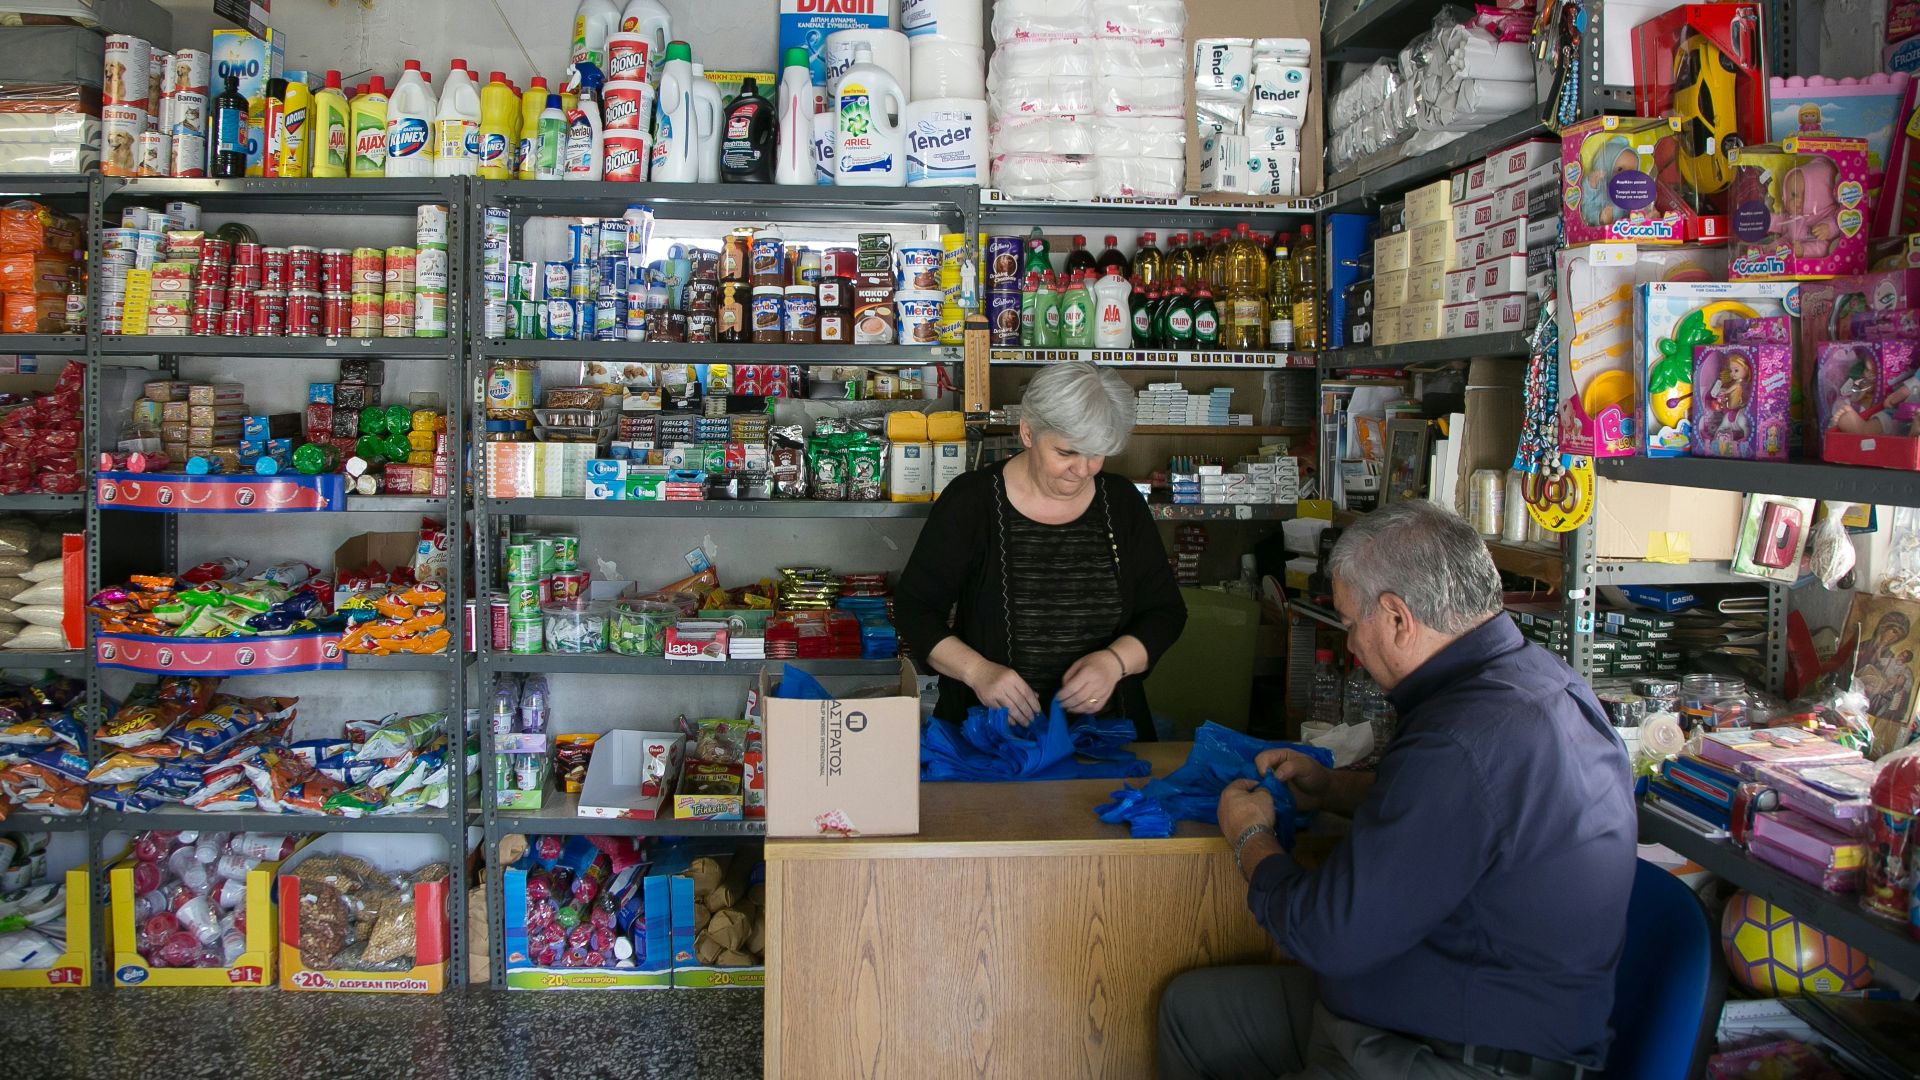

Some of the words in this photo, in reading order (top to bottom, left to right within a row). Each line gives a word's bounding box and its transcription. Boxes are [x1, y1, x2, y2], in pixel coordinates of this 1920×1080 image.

[105, 41, 129, 50] arron
[218, 59, 260, 78] OMO
[610, 51, 645, 74] BIONOL
[1255, 84, 1300, 101] Tender
[104, 110, 137, 121] Barron
[605, 101, 638, 123] BIONOL
[388, 131, 426, 149] KLINEX
[844, 138, 872, 147] ARIEL
[908, 126, 972, 153] Tender
[651, 143, 668, 158] RIEL
[605, 148, 640, 172] BIONOL
[1065, 312, 1082, 320] FAIRY
[1104, 304, 1121, 323] AVA
[1172, 317, 1190, 326] FAIRY
[1197, 319, 1214, 329] FAIRY
[1093, 352, 1134, 361] SILK
[1192, 355, 1232, 364] SILK
[1671, 595, 1694, 606] CASIO
[829, 700, 842, 776] ΑΣΤΡΑΤΟΣ
[292, 972, 335, 989] +20%
[339, 979, 382, 990] ΔΩΡΕΑΝ
[541, 973, 569, 987] +20%
